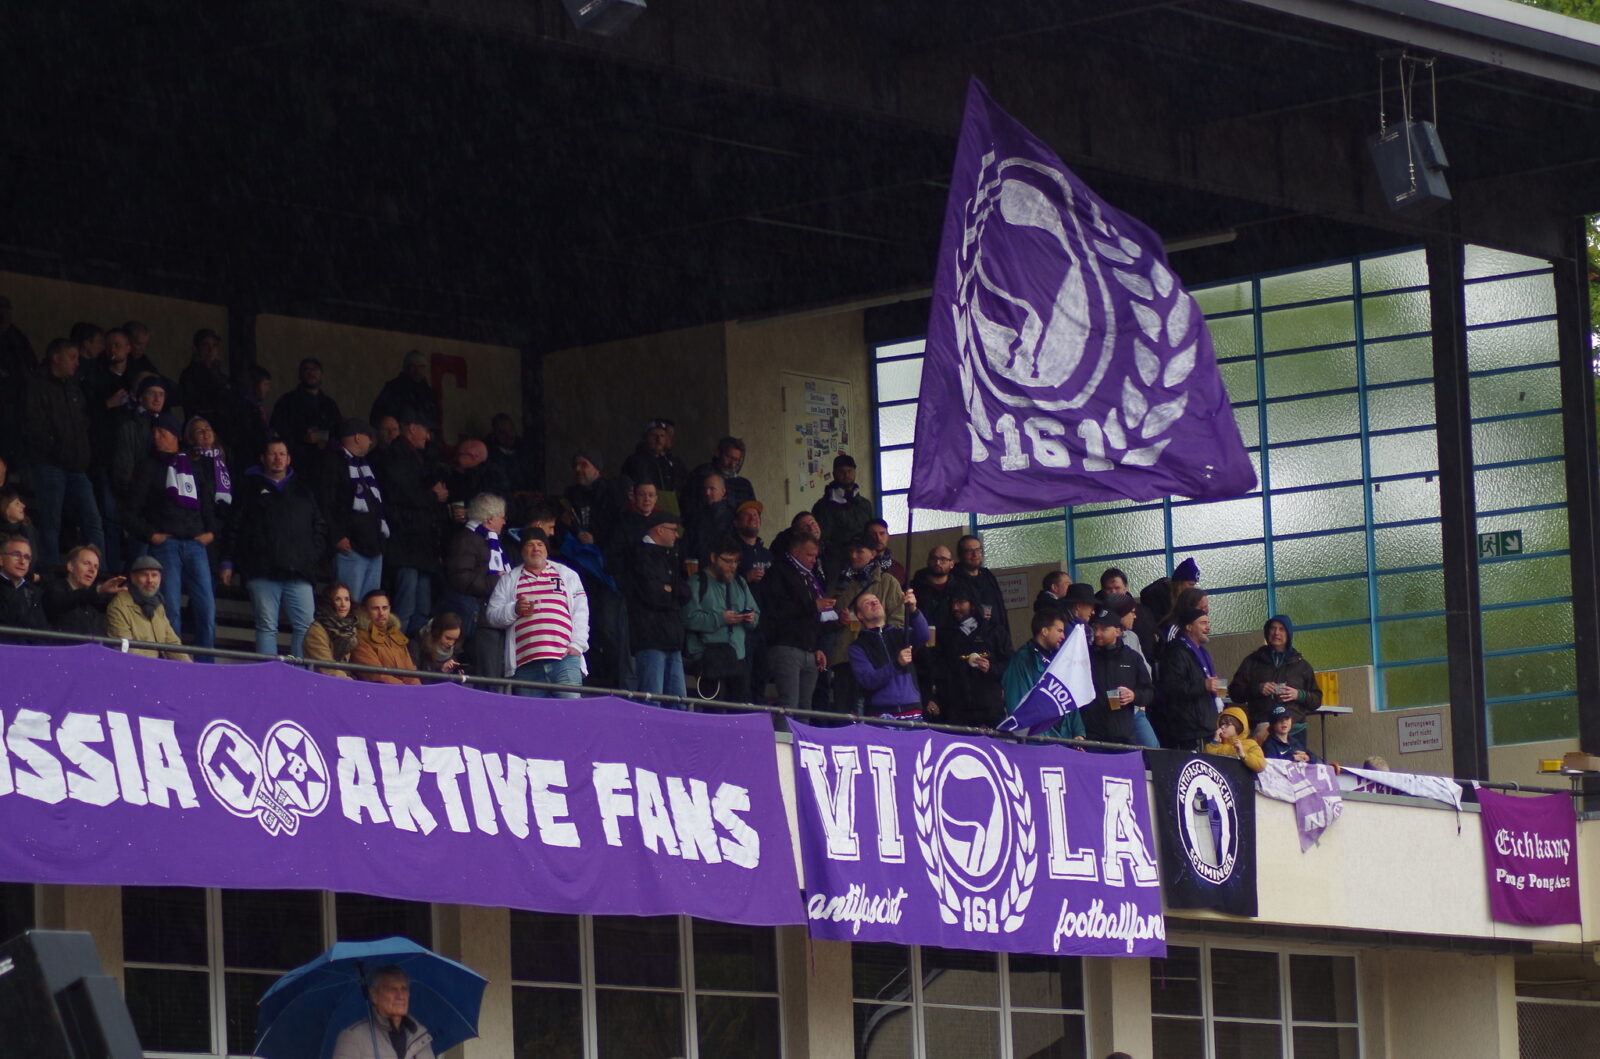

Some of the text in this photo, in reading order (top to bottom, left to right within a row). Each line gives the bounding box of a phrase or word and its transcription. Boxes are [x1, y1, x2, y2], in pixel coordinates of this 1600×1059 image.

[996, 413, 1114, 471] 161
[550, 577, 562, 592] T
[1047, 678, 1072, 714] VIOL
[0, 707, 760, 869] SSIA AKTIVE FANS
[1179, 763, 1233, 809] ANTIFASCHISTISCHE
[1190, 848, 1234, 880] SCHMINGER
[1495, 828, 1570, 865] Eichkamp
[963, 896, 999, 933] 161
